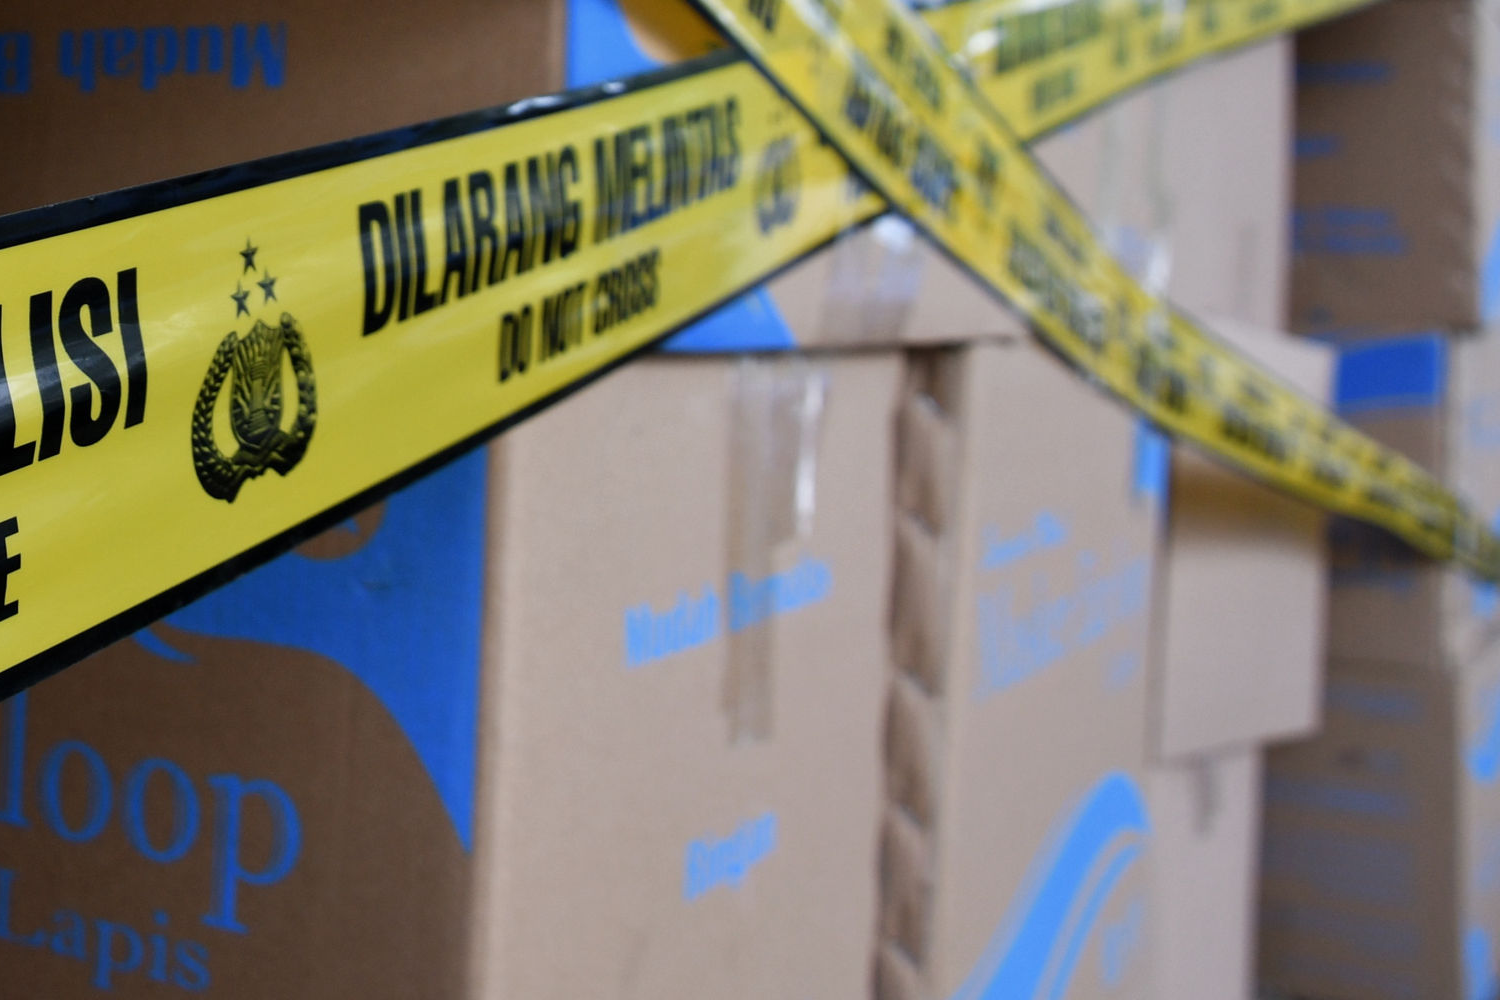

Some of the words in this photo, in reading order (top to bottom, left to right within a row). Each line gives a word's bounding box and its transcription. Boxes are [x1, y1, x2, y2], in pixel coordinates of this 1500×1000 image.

[58, 21, 287, 94] Mudah
[357, 144, 581, 338] DILARANG
[592, 95, 744, 244] MELINTAS
[498, 304, 535, 383] DO
[539, 280, 588, 363] NOT
[592, 247, 663, 336] CROSS
